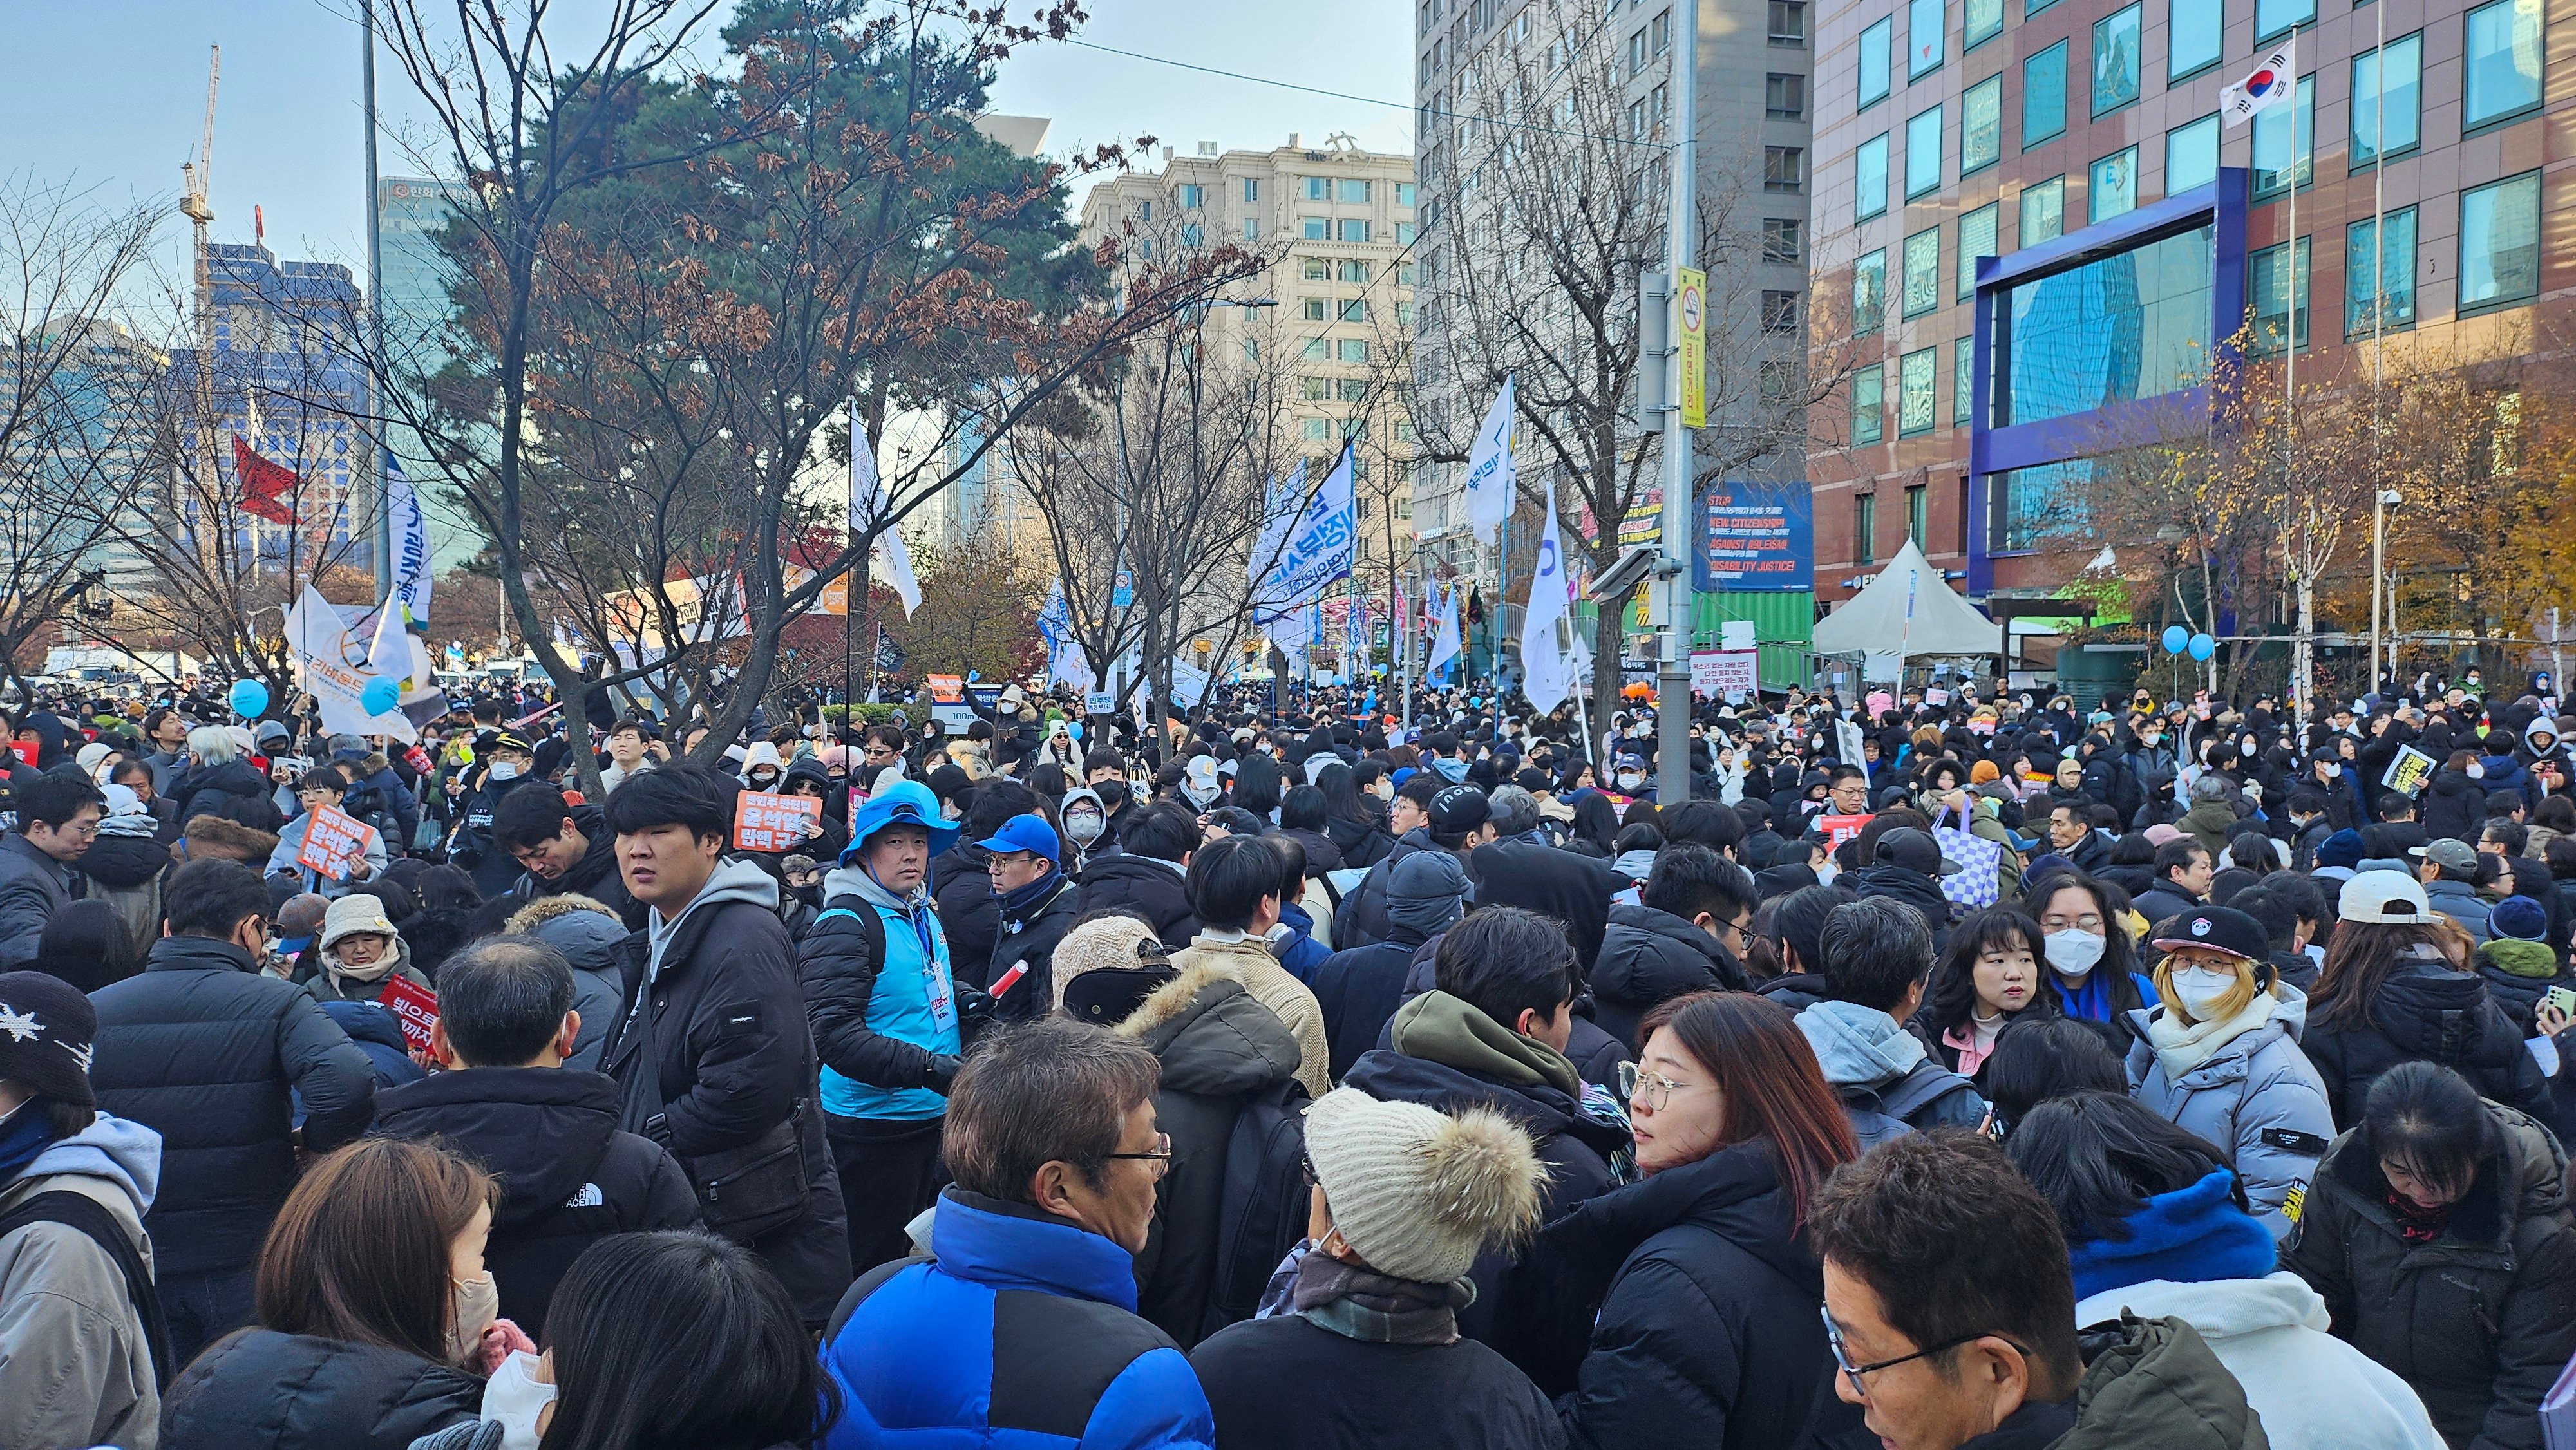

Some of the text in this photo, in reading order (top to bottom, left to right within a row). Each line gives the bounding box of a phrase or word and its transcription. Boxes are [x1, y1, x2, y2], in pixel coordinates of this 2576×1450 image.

[410, 185, 433, 198] 한화
[1709, 495, 1732, 507] STOP
[1709, 518, 1785, 528] NEW CITIZENSHIP!
[1710, 538, 1745, 549] AGAINST
[1710, 560, 1795, 572] DISABILITY JUSTICE!
[974, 694, 999, 702] 국방송
[1089, 696, 1111, 704] 민주당
[743, 807, 801, 831] 윤석열
[311, 822, 354, 856] 윤석열
[741, 828, 772, 849] 탄핵
[303, 842, 328, 869] 탄핵
